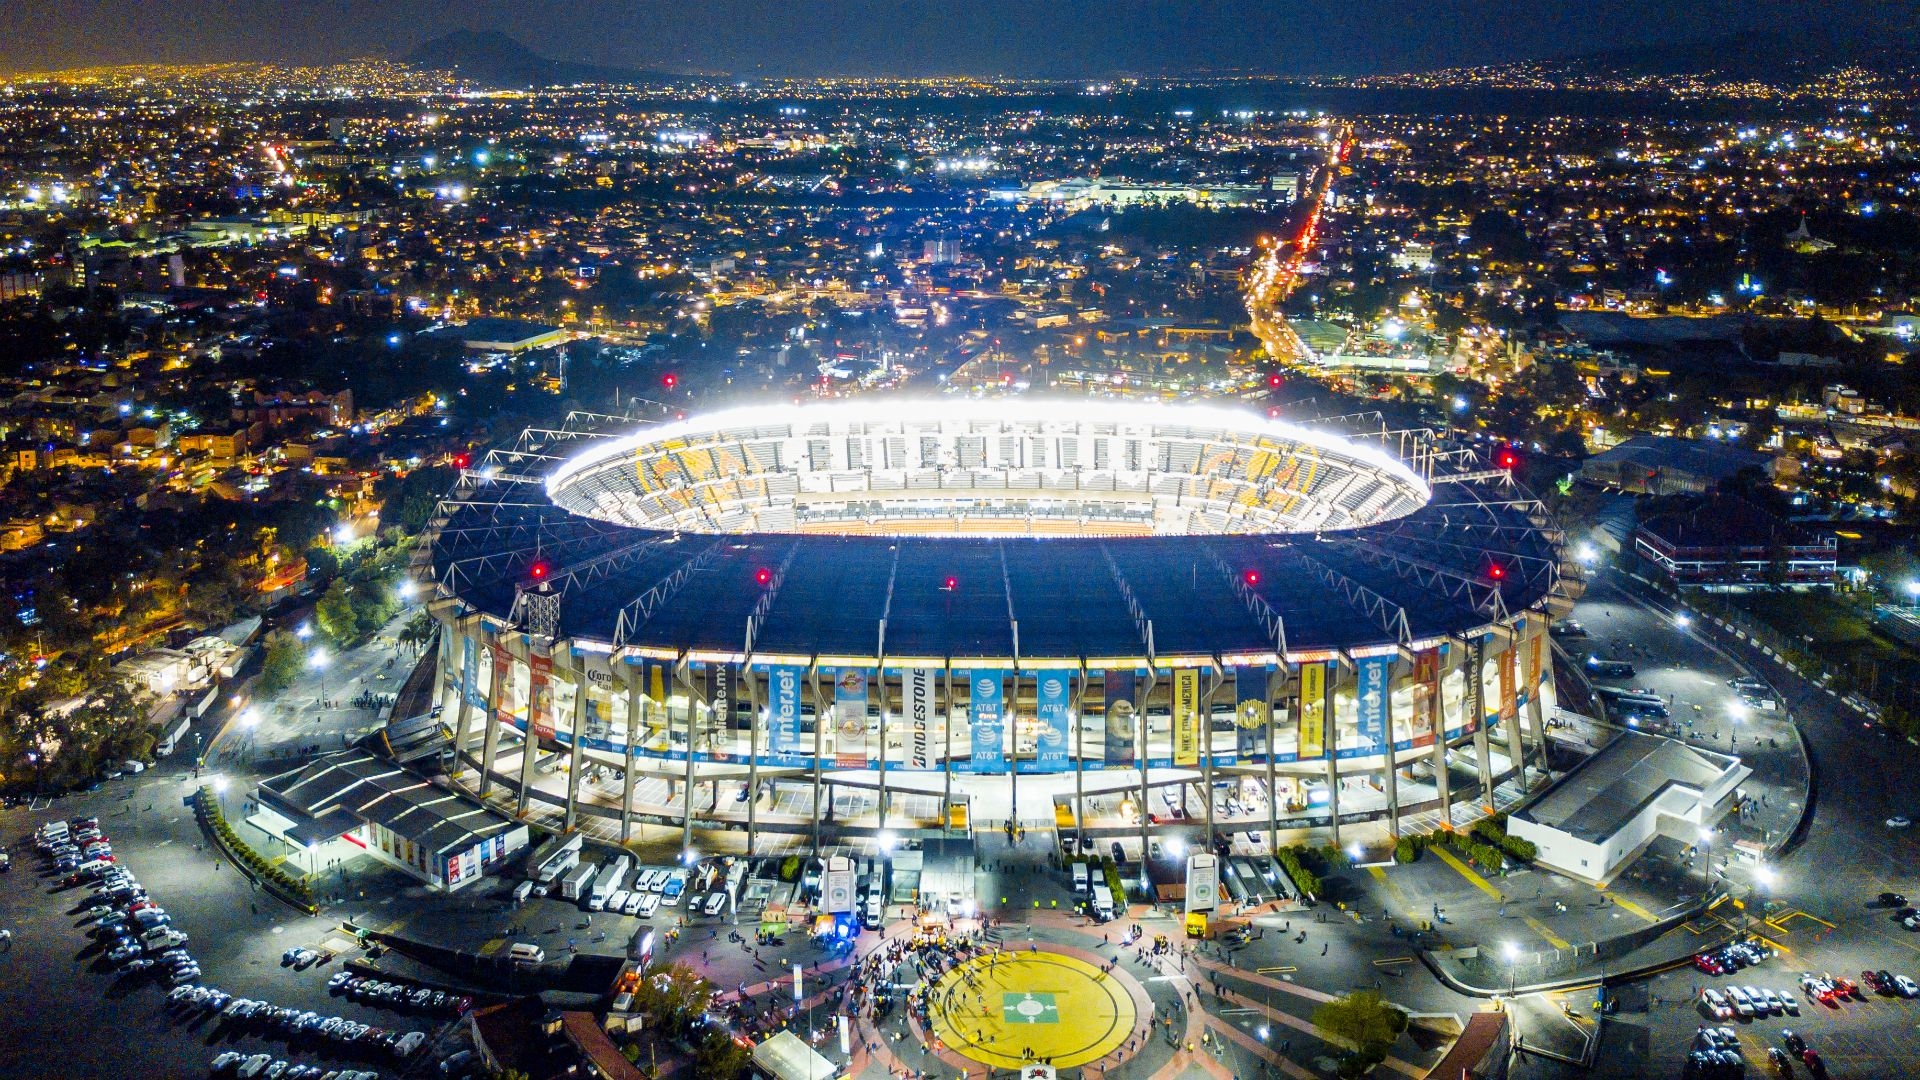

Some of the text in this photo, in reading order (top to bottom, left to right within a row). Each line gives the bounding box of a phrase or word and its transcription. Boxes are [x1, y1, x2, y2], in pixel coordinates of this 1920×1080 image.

[715, 664, 728, 746] caliente.mx
[975, 703, 998, 712] AT&T
[1041, 704, 1064, 712] AT&T
[913, 668, 926, 768] BRIDGESTONE
[534, 723, 554, 734] TOTAL
[976, 751, 998, 760] AT&T
[1041, 752, 1064, 760] AT&T
